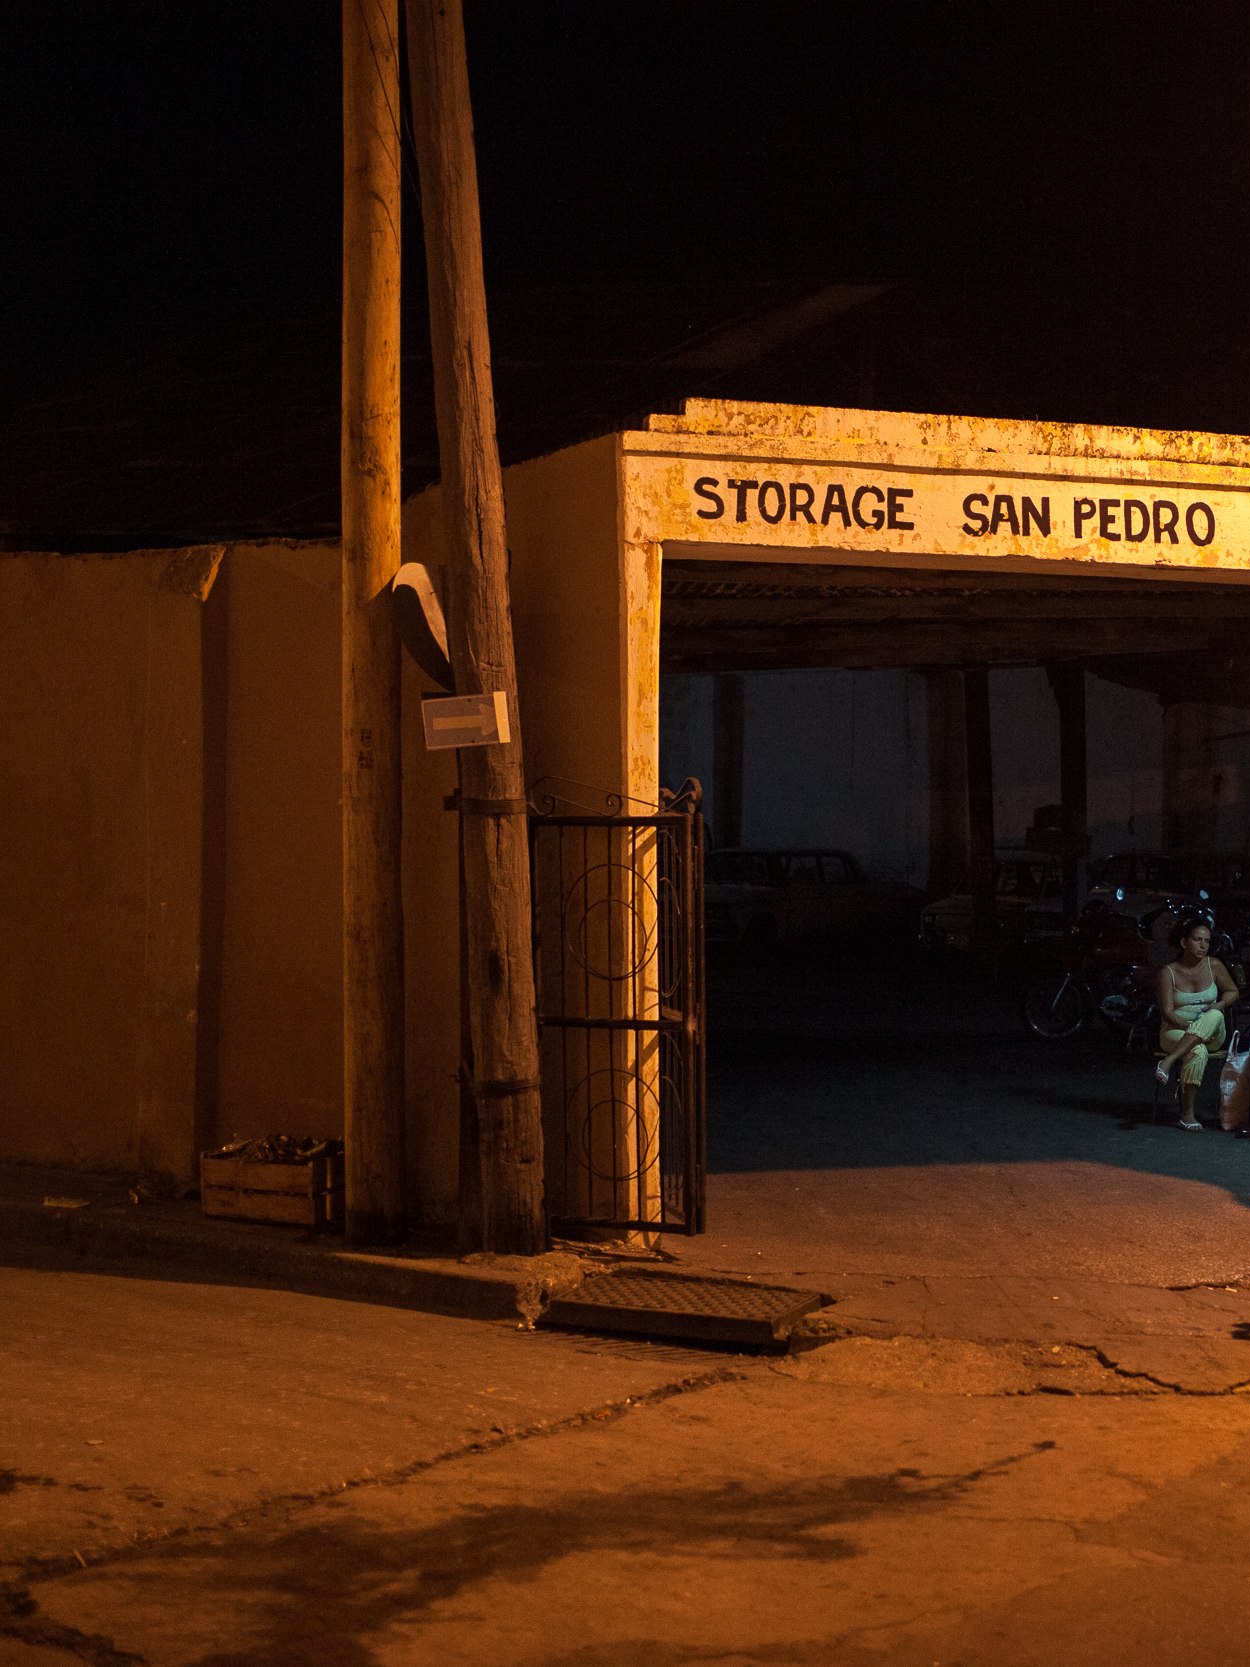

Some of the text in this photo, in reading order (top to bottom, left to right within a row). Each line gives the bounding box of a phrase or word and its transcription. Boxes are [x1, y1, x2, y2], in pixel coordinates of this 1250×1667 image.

[693, 476, 1216, 547] STORAGE SAN PEDRO
